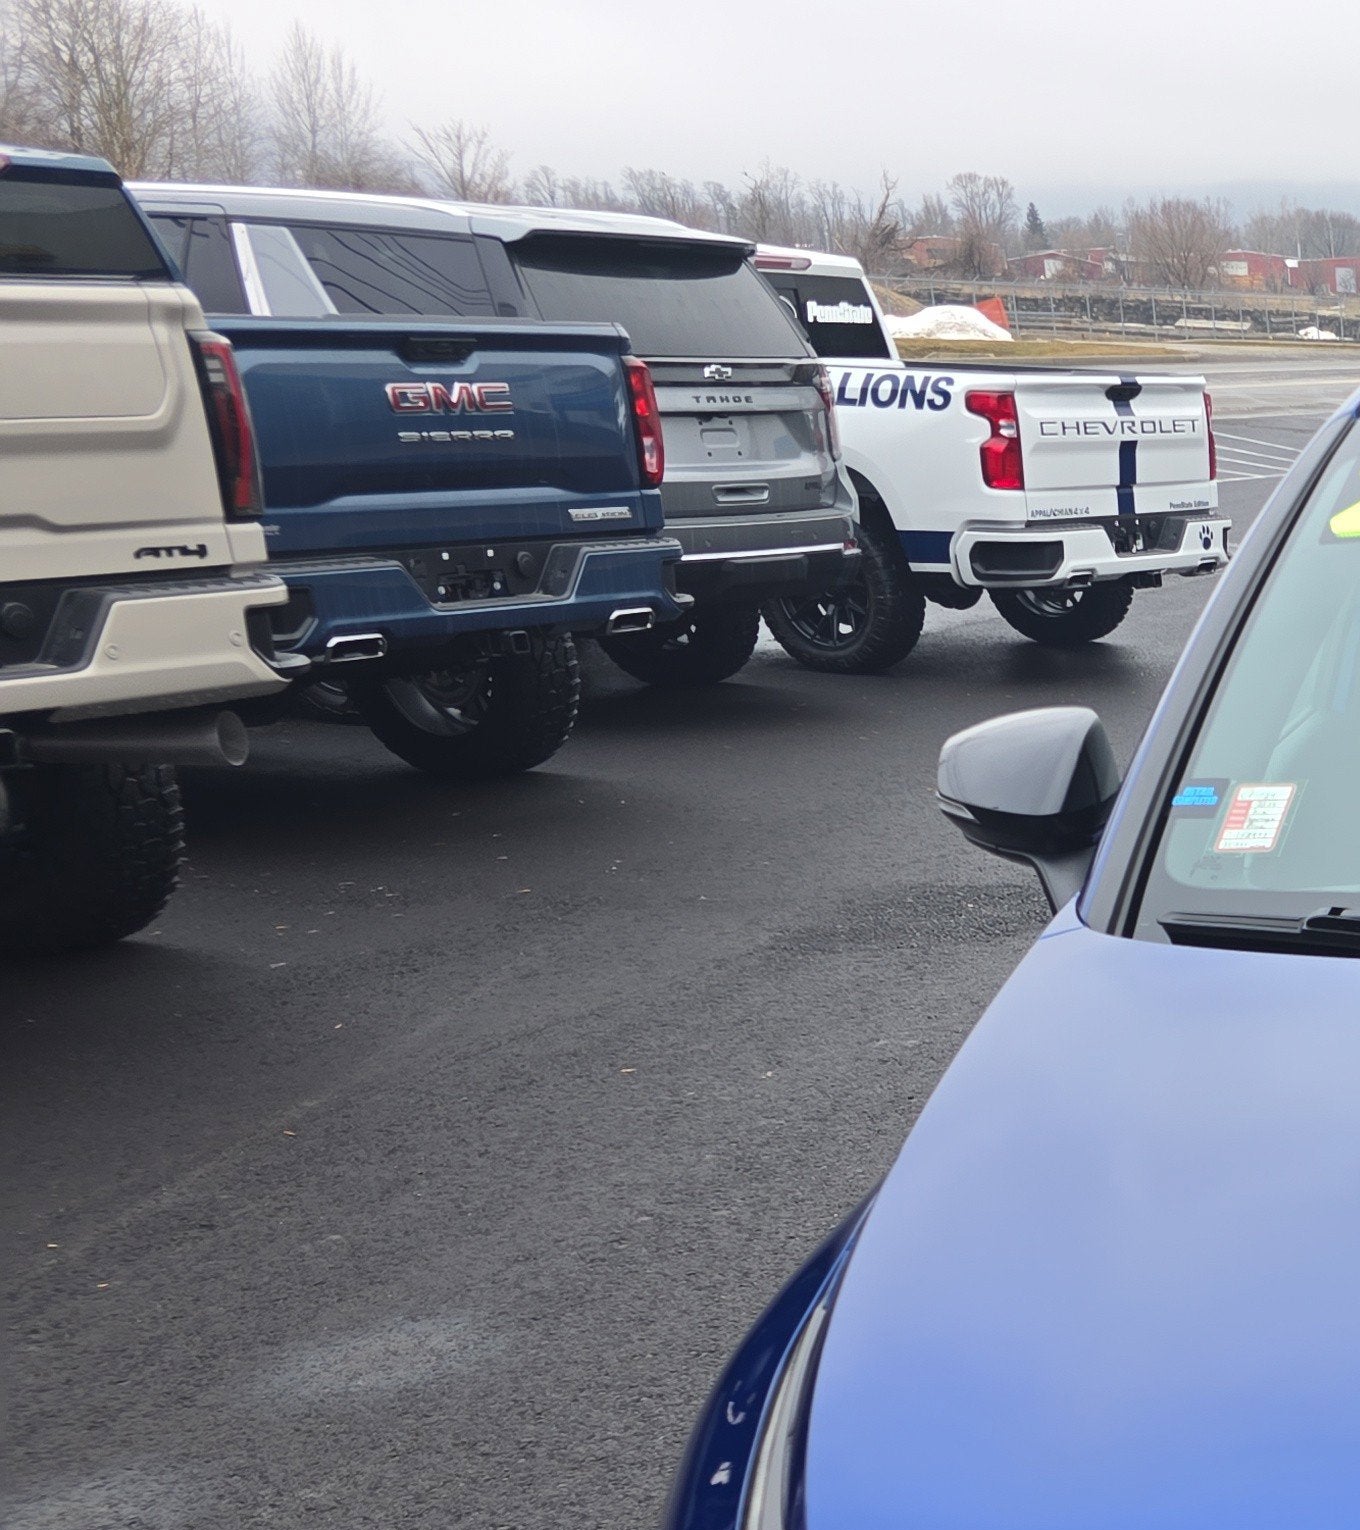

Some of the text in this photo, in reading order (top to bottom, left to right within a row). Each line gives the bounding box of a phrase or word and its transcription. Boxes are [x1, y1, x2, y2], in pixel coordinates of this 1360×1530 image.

[384, 381, 515, 416] GMC
[691, 395, 754, 404] TAHOE
[835, 371, 955, 412] LIONS
[396, 429, 515, 443] SIERRA
[1039, 418, 1200, 437] CHEVROLET
[132, 543, 208, 560] AT4
